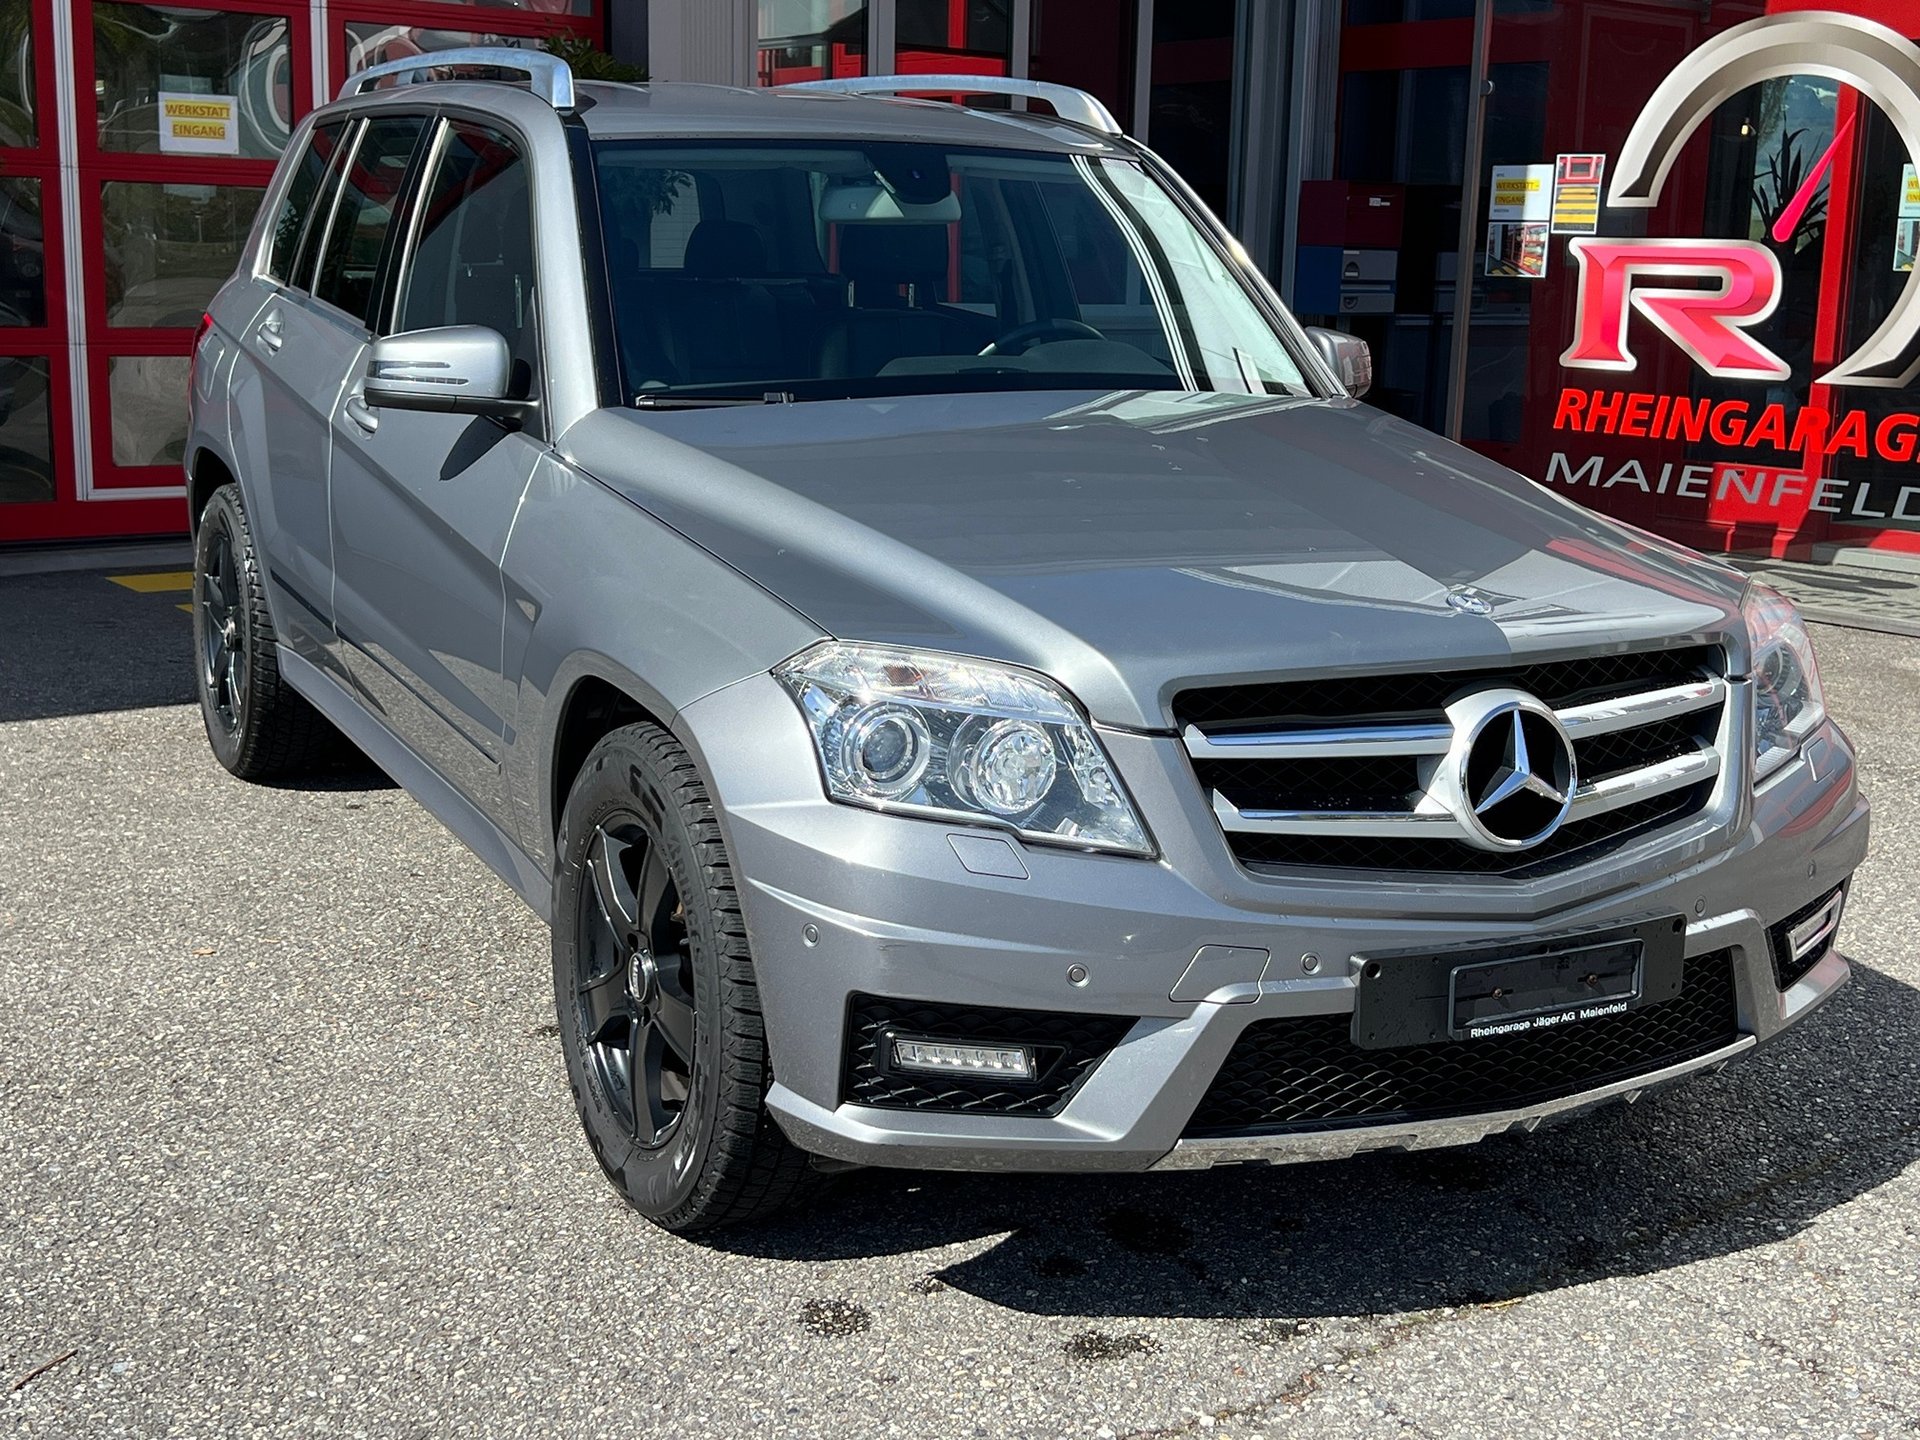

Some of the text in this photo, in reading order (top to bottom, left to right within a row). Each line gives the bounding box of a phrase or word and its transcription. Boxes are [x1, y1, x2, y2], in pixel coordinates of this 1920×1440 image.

[165, 104, 231, 117] WERKSTATT
[172, 124, 226, 137] EINGANG
[1553, 388, 1920, 464] RHEINGARAG
[1471, 1021, 1530, 1038] Rheingarage
[1580, 1002, 1627, 1018] Maienfeld
